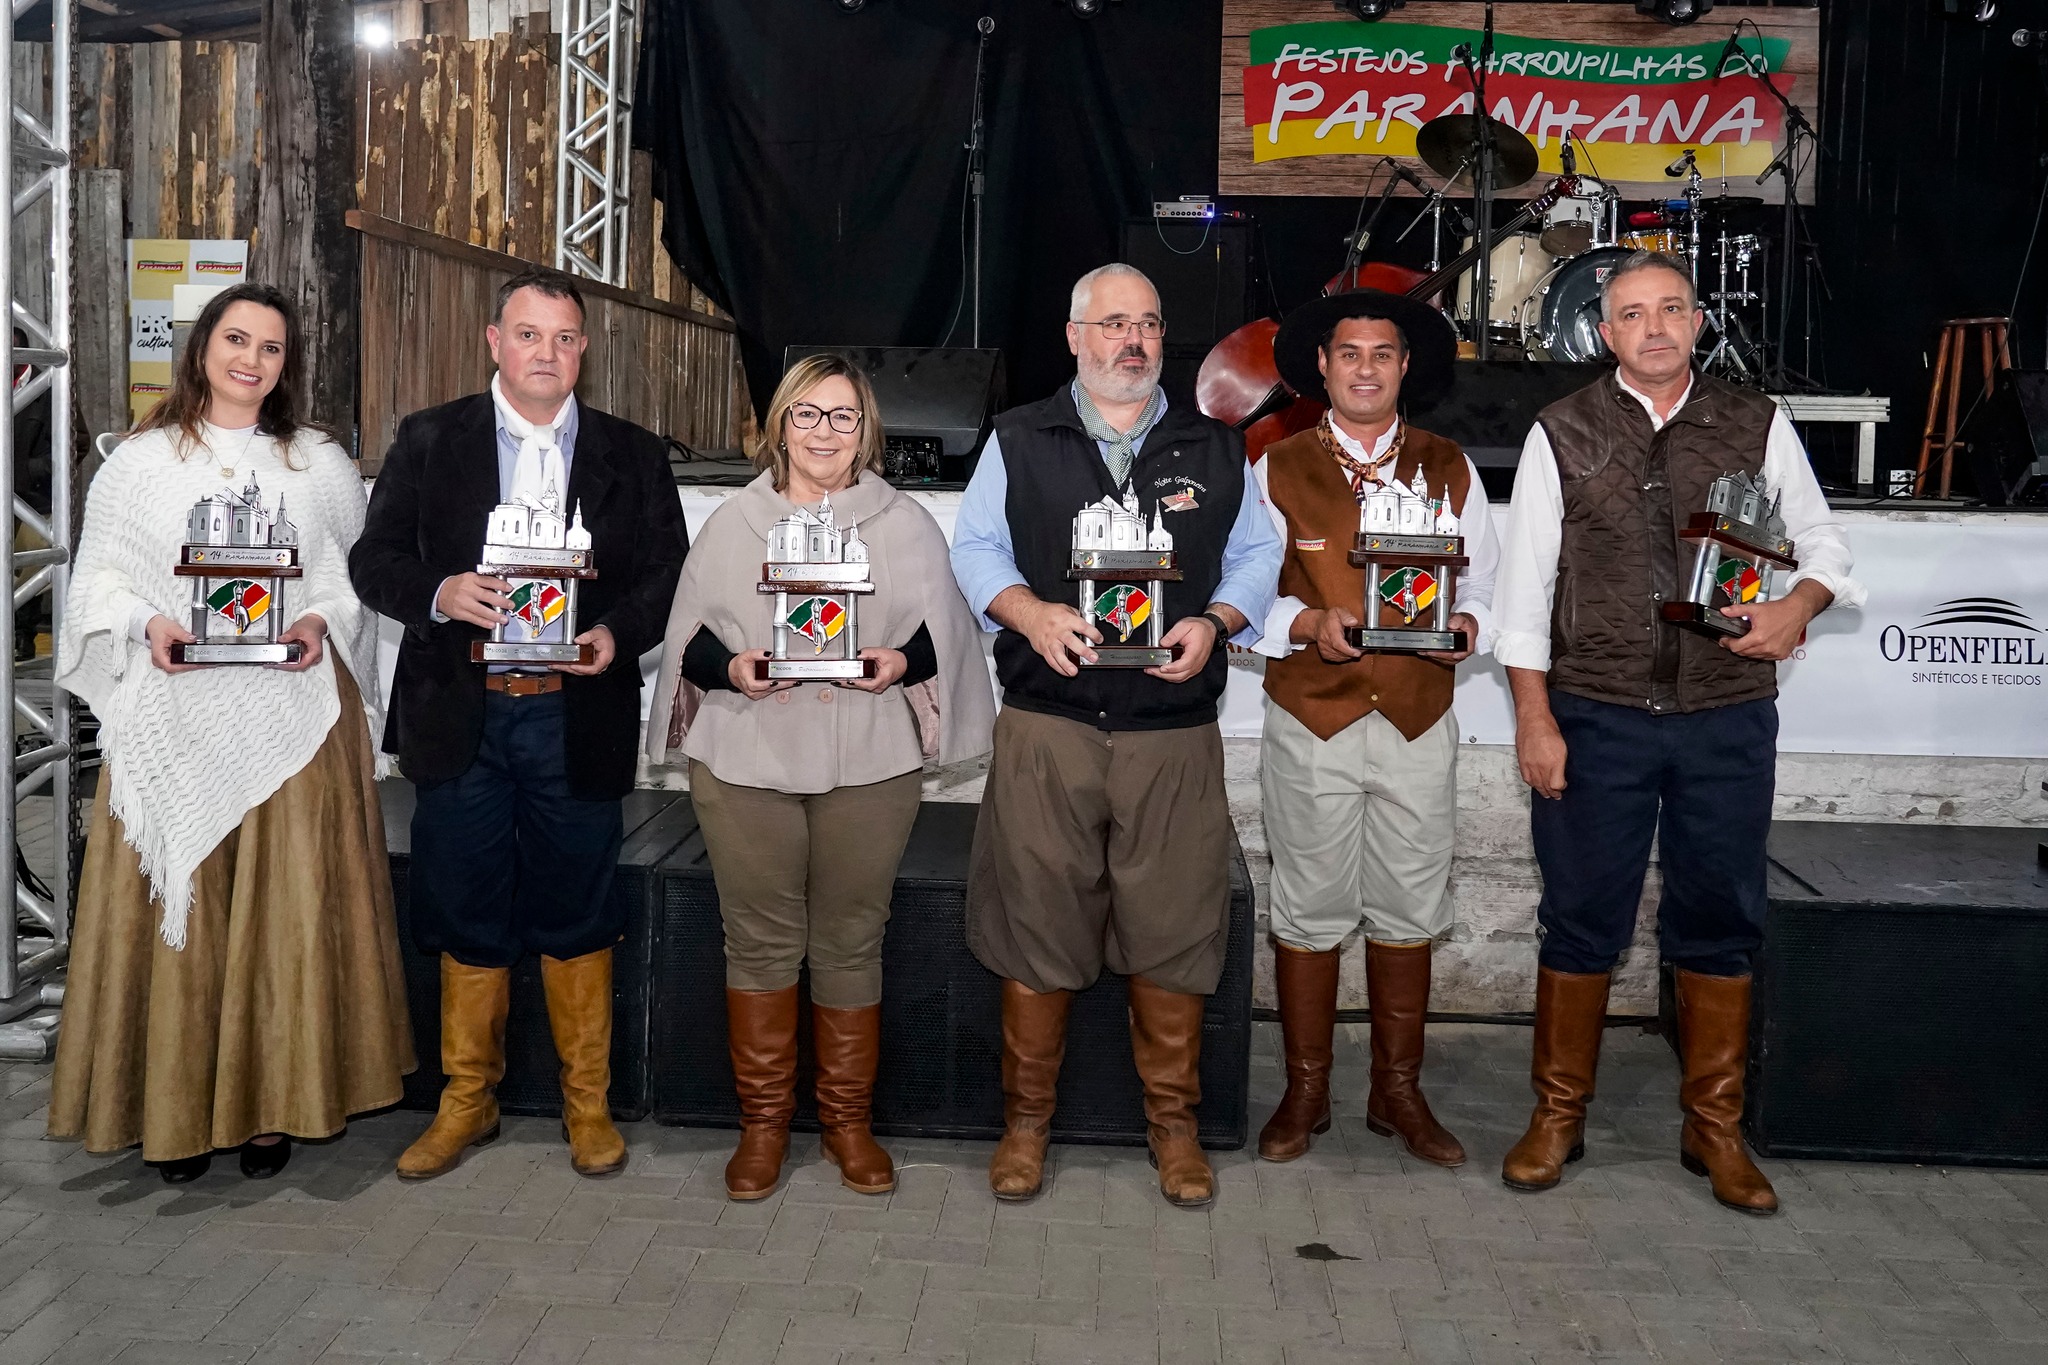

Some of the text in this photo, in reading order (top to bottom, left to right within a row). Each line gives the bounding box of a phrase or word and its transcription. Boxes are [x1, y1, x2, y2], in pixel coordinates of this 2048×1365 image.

[1272, 43, 1428, 79] FESTEJOS
[1718, 53, 1769, 79] DO
[1268, 80, 1764, 149] PARANHANA
[1880, 624, 2048, 665] OPENFIEL
[1228, 659, 1256, 667] ODOS
[1912, 671, 2042, 686] SINTÉTICOS E TECIDOS
